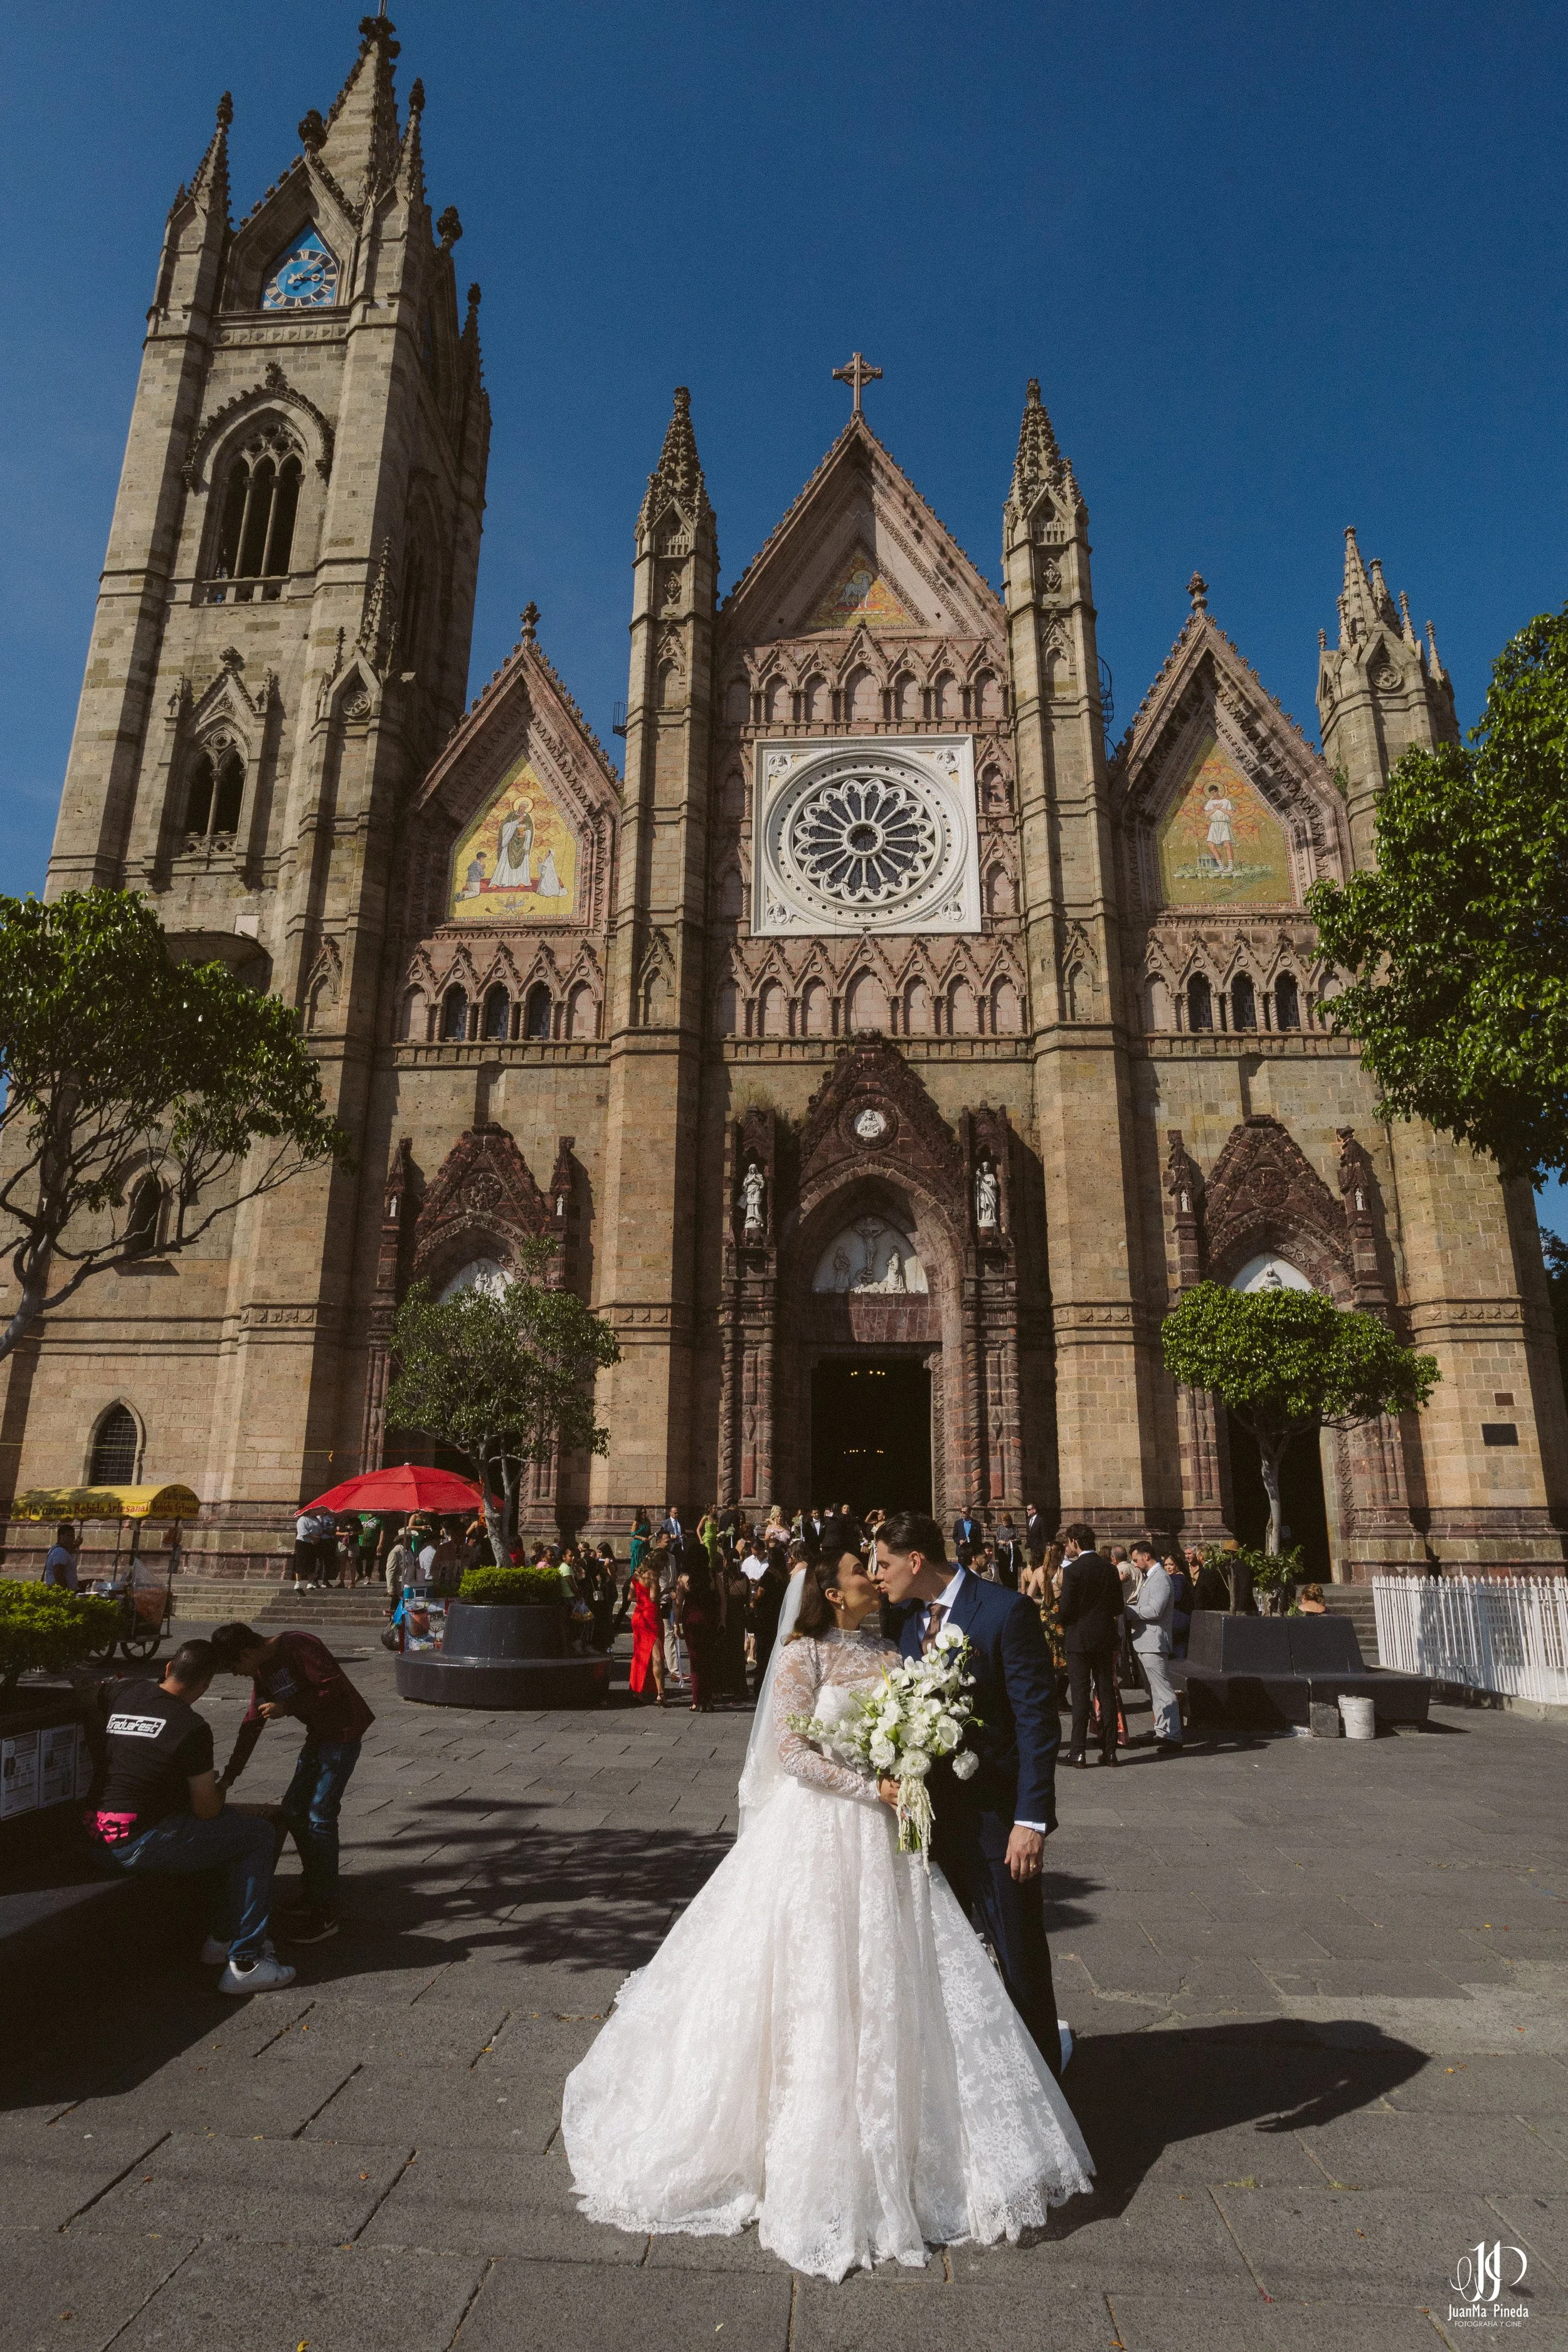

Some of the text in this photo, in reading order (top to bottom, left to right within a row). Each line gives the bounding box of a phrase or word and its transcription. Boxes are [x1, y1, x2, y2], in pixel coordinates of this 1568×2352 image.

[26, 1505, 72, 1515] Teuinera
[75, 1502, 104, 1513] Bebida
[105, 1501, 149, 1513] Artesanal
